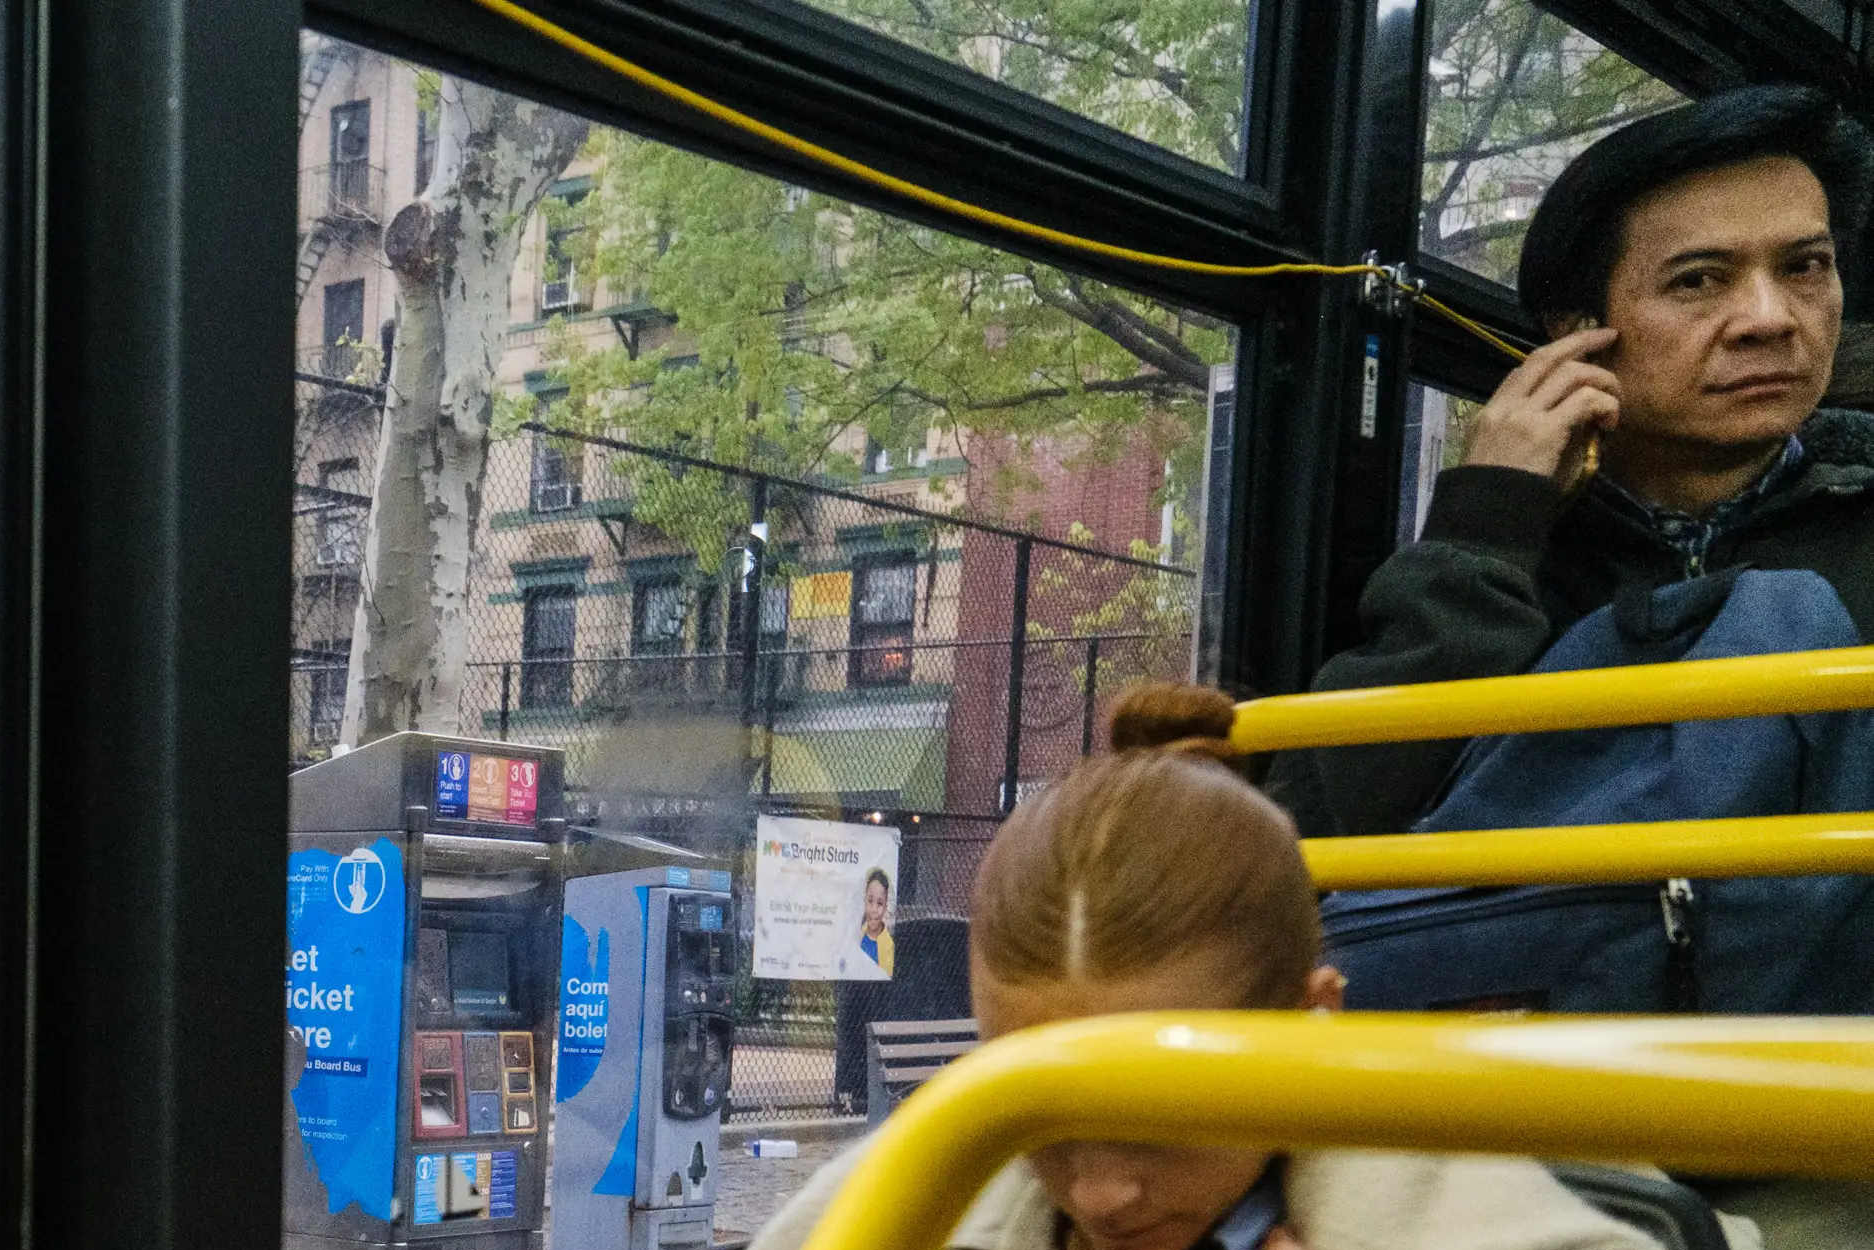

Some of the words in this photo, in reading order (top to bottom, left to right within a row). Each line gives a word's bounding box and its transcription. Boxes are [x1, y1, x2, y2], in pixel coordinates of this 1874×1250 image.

[441, 757, 447, 775] 1
[472, 761, 481, 778] 2
[511, 764, 518, 782] 3
[791, 842, 826, 865] Bright
[827, 846, 859, 865] Starts
[285, 944, 319, 972] et
[285, 981, 355, 1011] icket
[565, 1000, 605, 1020] aquí
[292, 1026, 332, 1049] re
[315, 1059, 342, 1071] Board
[343, 1061, 362, 1073] Bus
